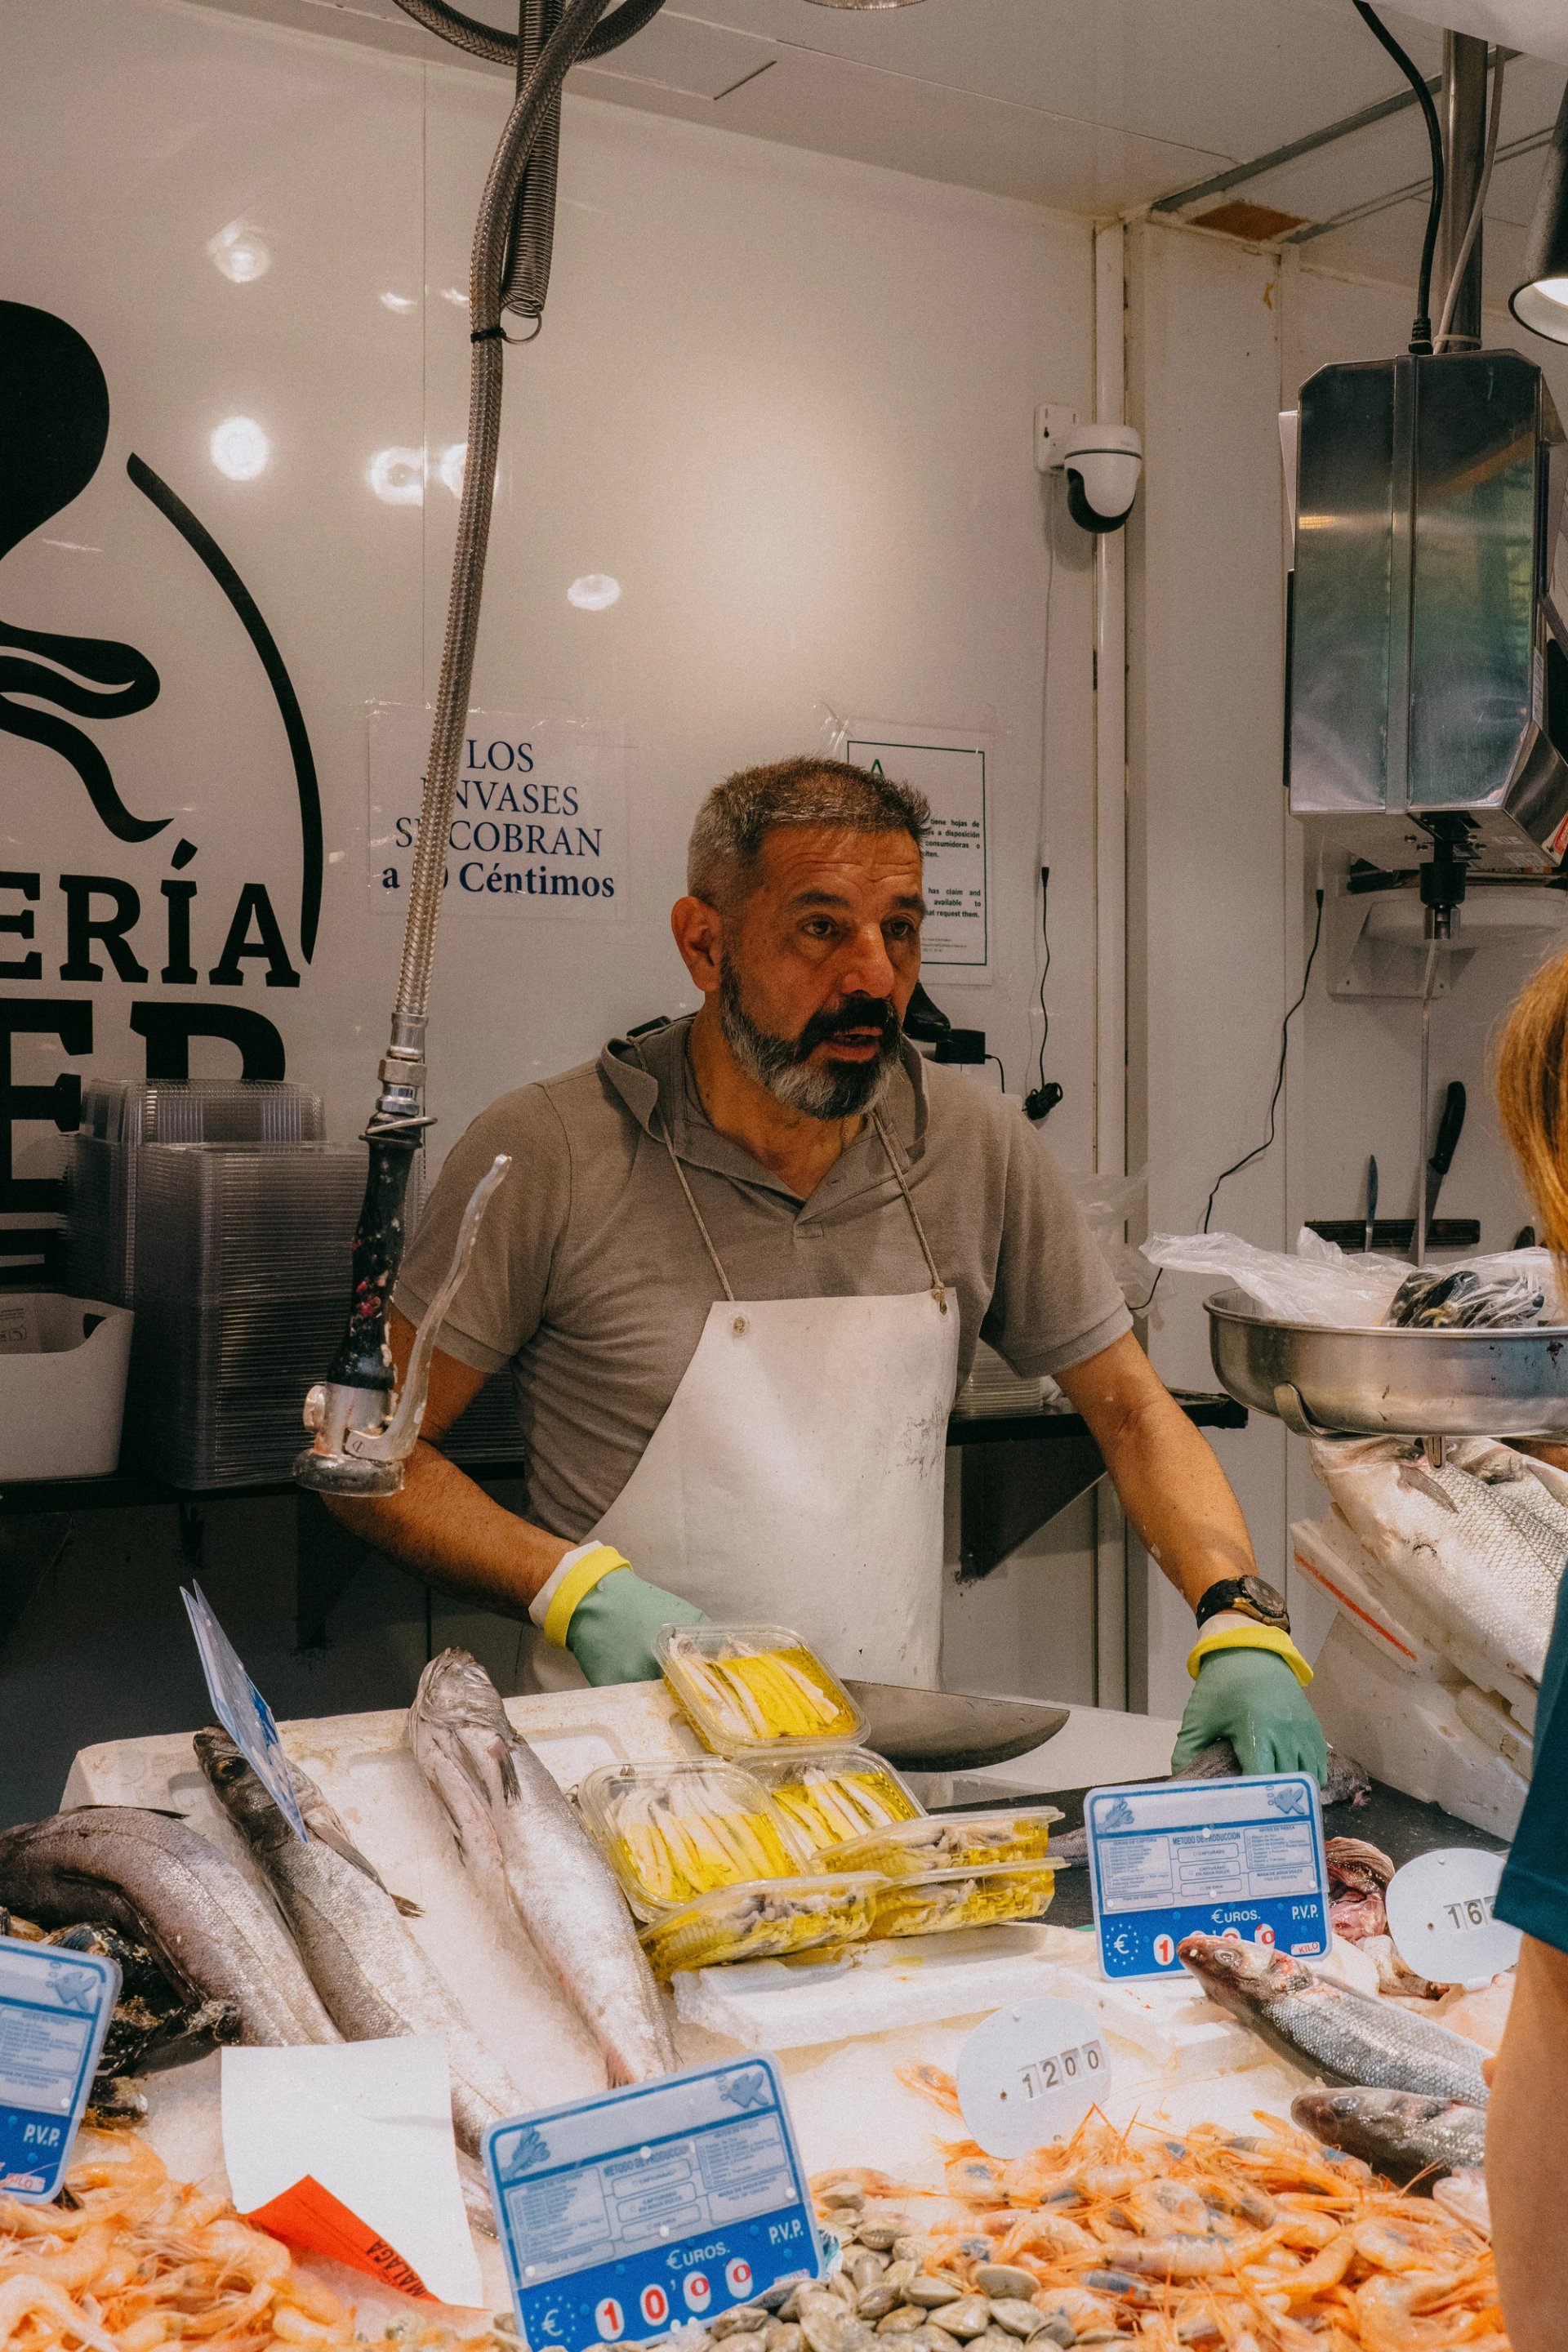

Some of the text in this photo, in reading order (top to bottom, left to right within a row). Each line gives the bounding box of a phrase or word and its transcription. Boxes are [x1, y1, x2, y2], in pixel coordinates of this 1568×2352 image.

[466, 739, 534, 773] LOS
[420, 777, 579, 816] NVASES
[930, 817, 947, 826] tiene
[951, 819, 968, 828] hojas
[945, 830, 980, 838] disposición
[395, 817, 603, 858] S COBRAN
[382, 867, 400, 889] a
[459, 862, 615, 898] Céntimos
[1291, 1904, 1319, 1920] P.V.P.
[1447, 1902, 1494, 1928] 16
[1298, 1942, 1318, 1954] KILO
[1022, 2050, 1099, 2098] 1200
[23, 2123, 61, 2148] P.V.P.
[768, 2219, 804, 2245] P.V.P.
